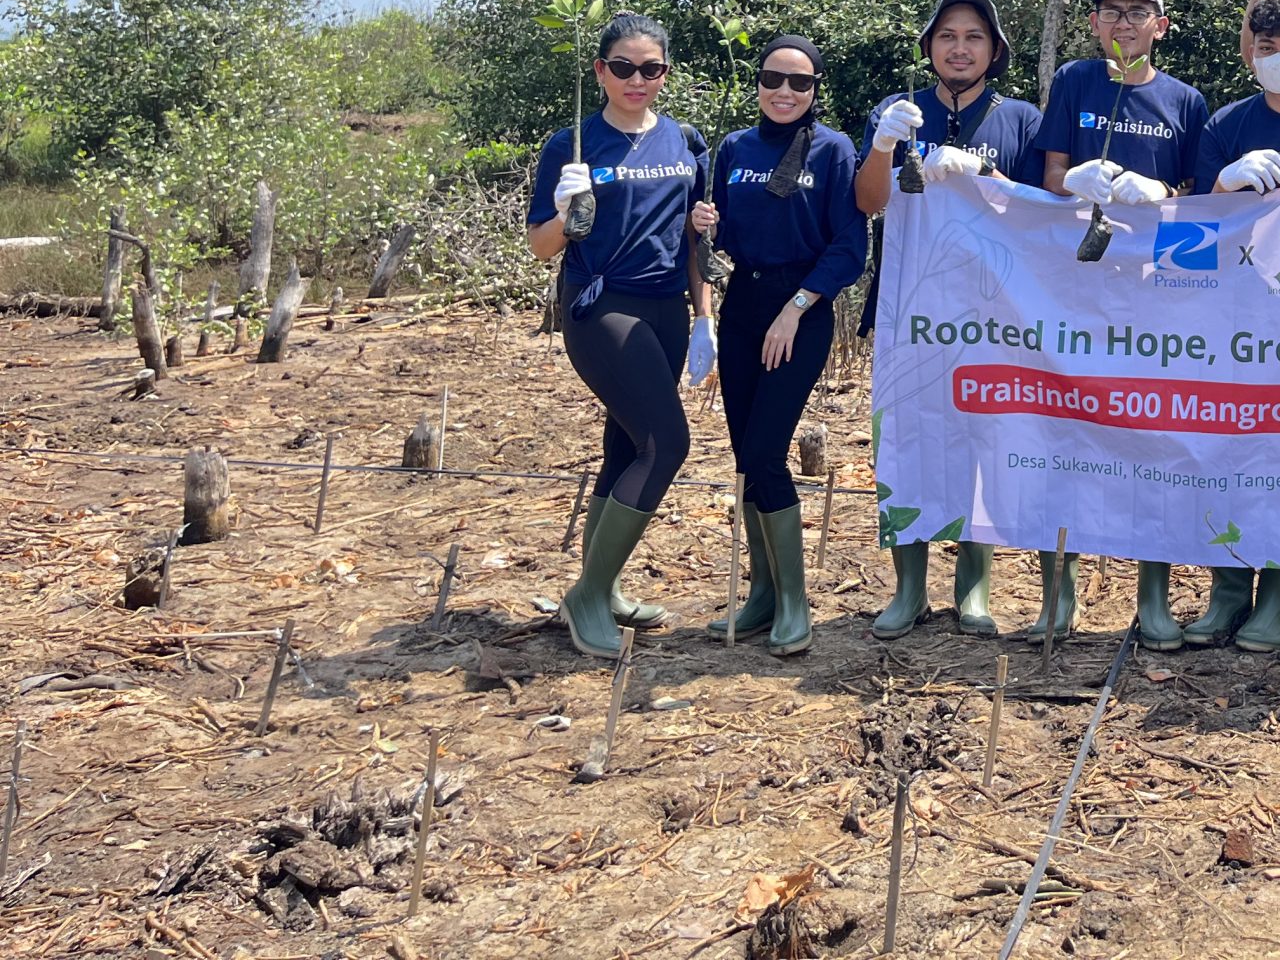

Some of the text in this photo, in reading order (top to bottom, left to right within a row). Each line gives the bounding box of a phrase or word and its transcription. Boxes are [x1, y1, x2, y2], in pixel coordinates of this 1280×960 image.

[616, 161, 692, 180] Praisindo
[1154, 273, 1219, 289] Praisindo
[910, 315, 1043, 351] Rooted
[1057, 321, 1092, 354] in
[1107, 325, 1217, 367] Hope,
[960, 378, 1099, 413] Praisindo
[1108, 392, 1162, 419] 500
[1008, 453, 1046, 469] Desa
[1052, 455, 1127, 479] Sukawali,
[1133, 463, 1228, 492] Kabupateng
